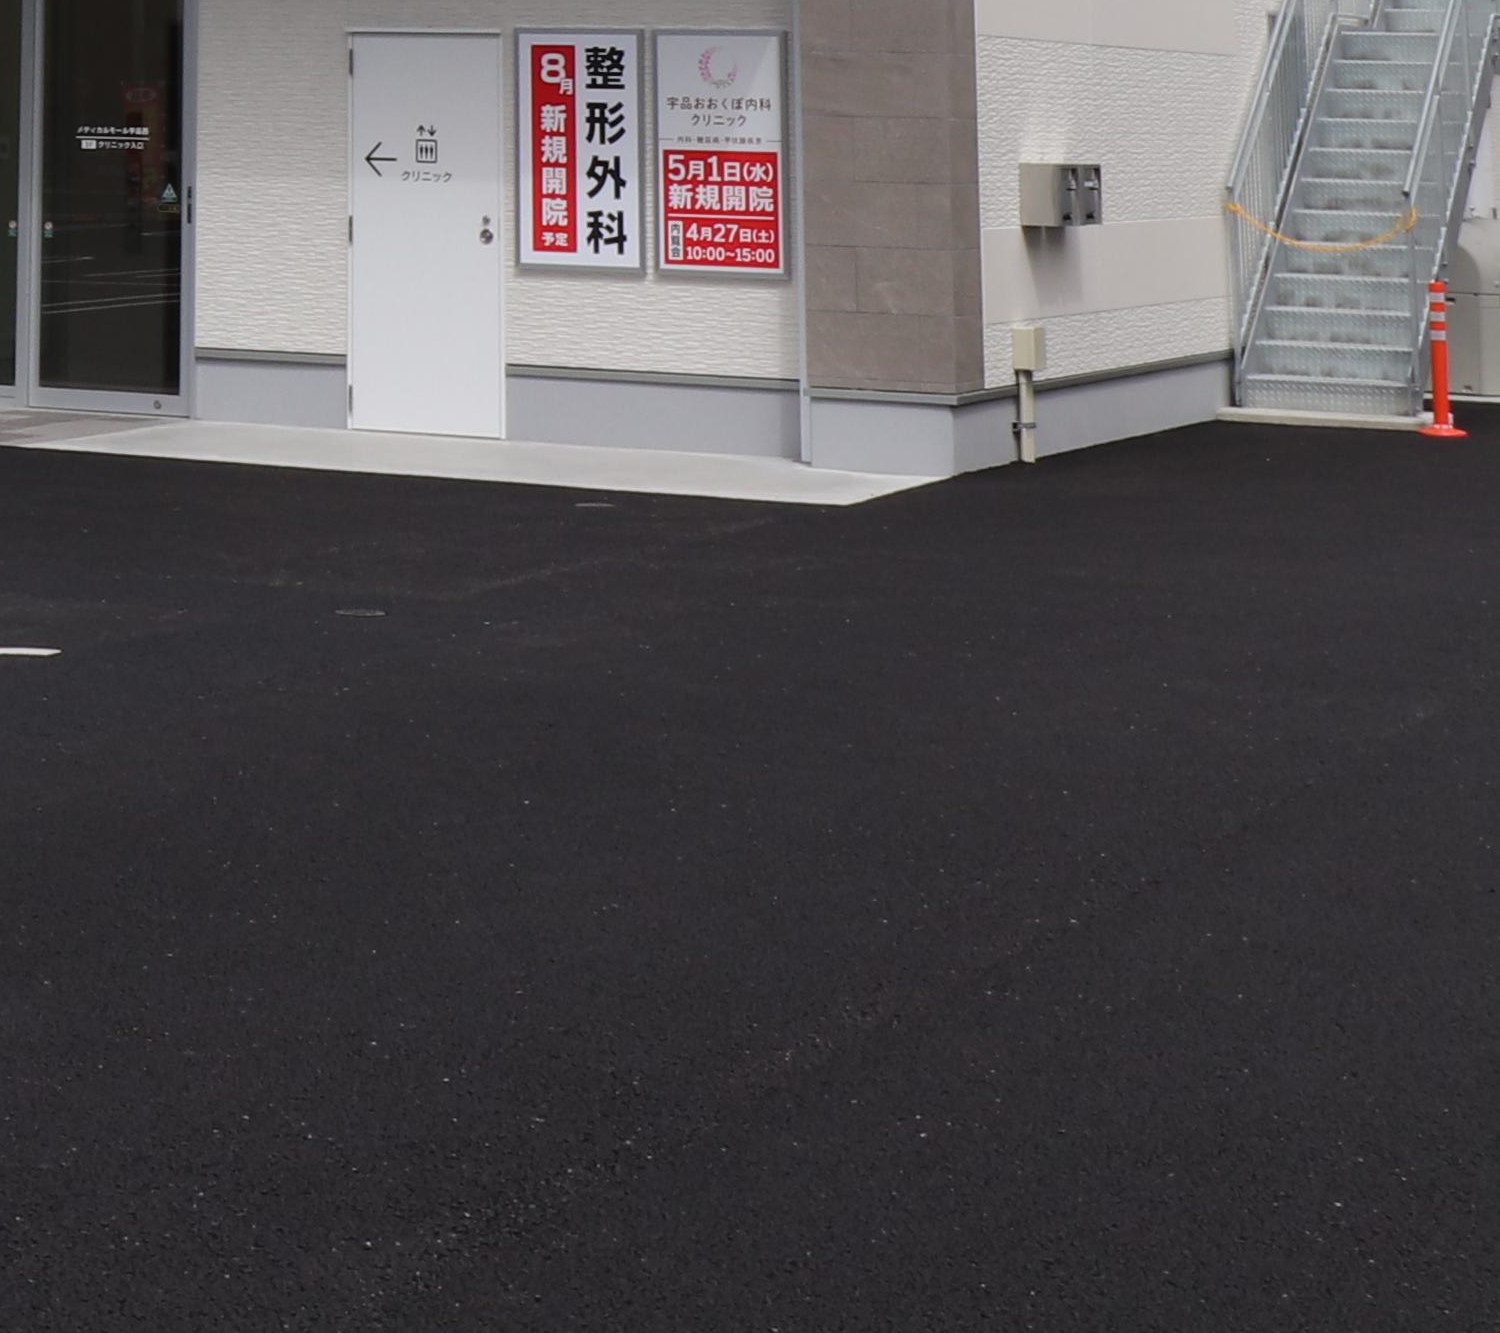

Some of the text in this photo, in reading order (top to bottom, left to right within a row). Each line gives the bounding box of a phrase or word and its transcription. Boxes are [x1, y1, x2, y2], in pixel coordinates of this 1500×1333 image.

[666, 96, 772, 111] 宇品おおくぼ内科
[691, 113, 747, 127] クリニック
[98, 141, 145, 151] クリニック入口
[584, 46, 628, 256] 整形外科
[401, 170, 452, 183] クリニック
[667, 154, 774, 182] 5月1日(水)
[668, 183, 775, 212] 新規開院
[686, 223, 775, 243] 4月27日(土)
